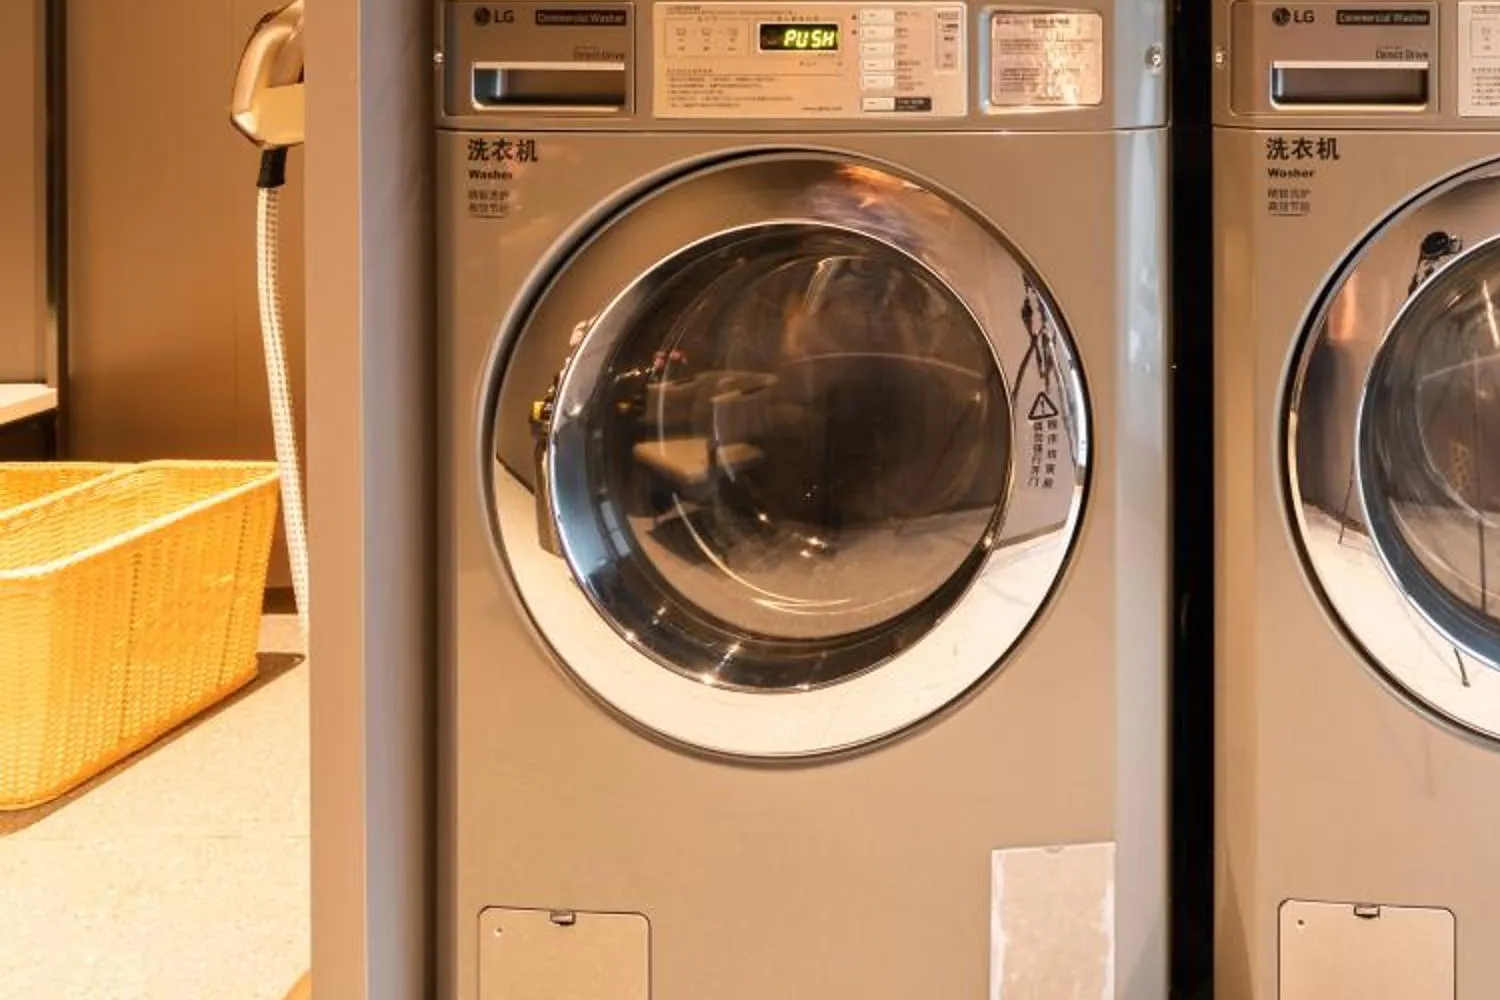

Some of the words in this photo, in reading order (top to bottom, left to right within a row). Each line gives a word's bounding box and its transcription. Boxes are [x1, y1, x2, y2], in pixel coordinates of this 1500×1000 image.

[783, 29, 836, 47] PUSH
[467, 138, 539, 162] 洗衣机
[1266, 137, 1341, 161] 洗衣机
[468, 169, 513, 180] Washer
[1268, 168, 1315, 178] Washer
